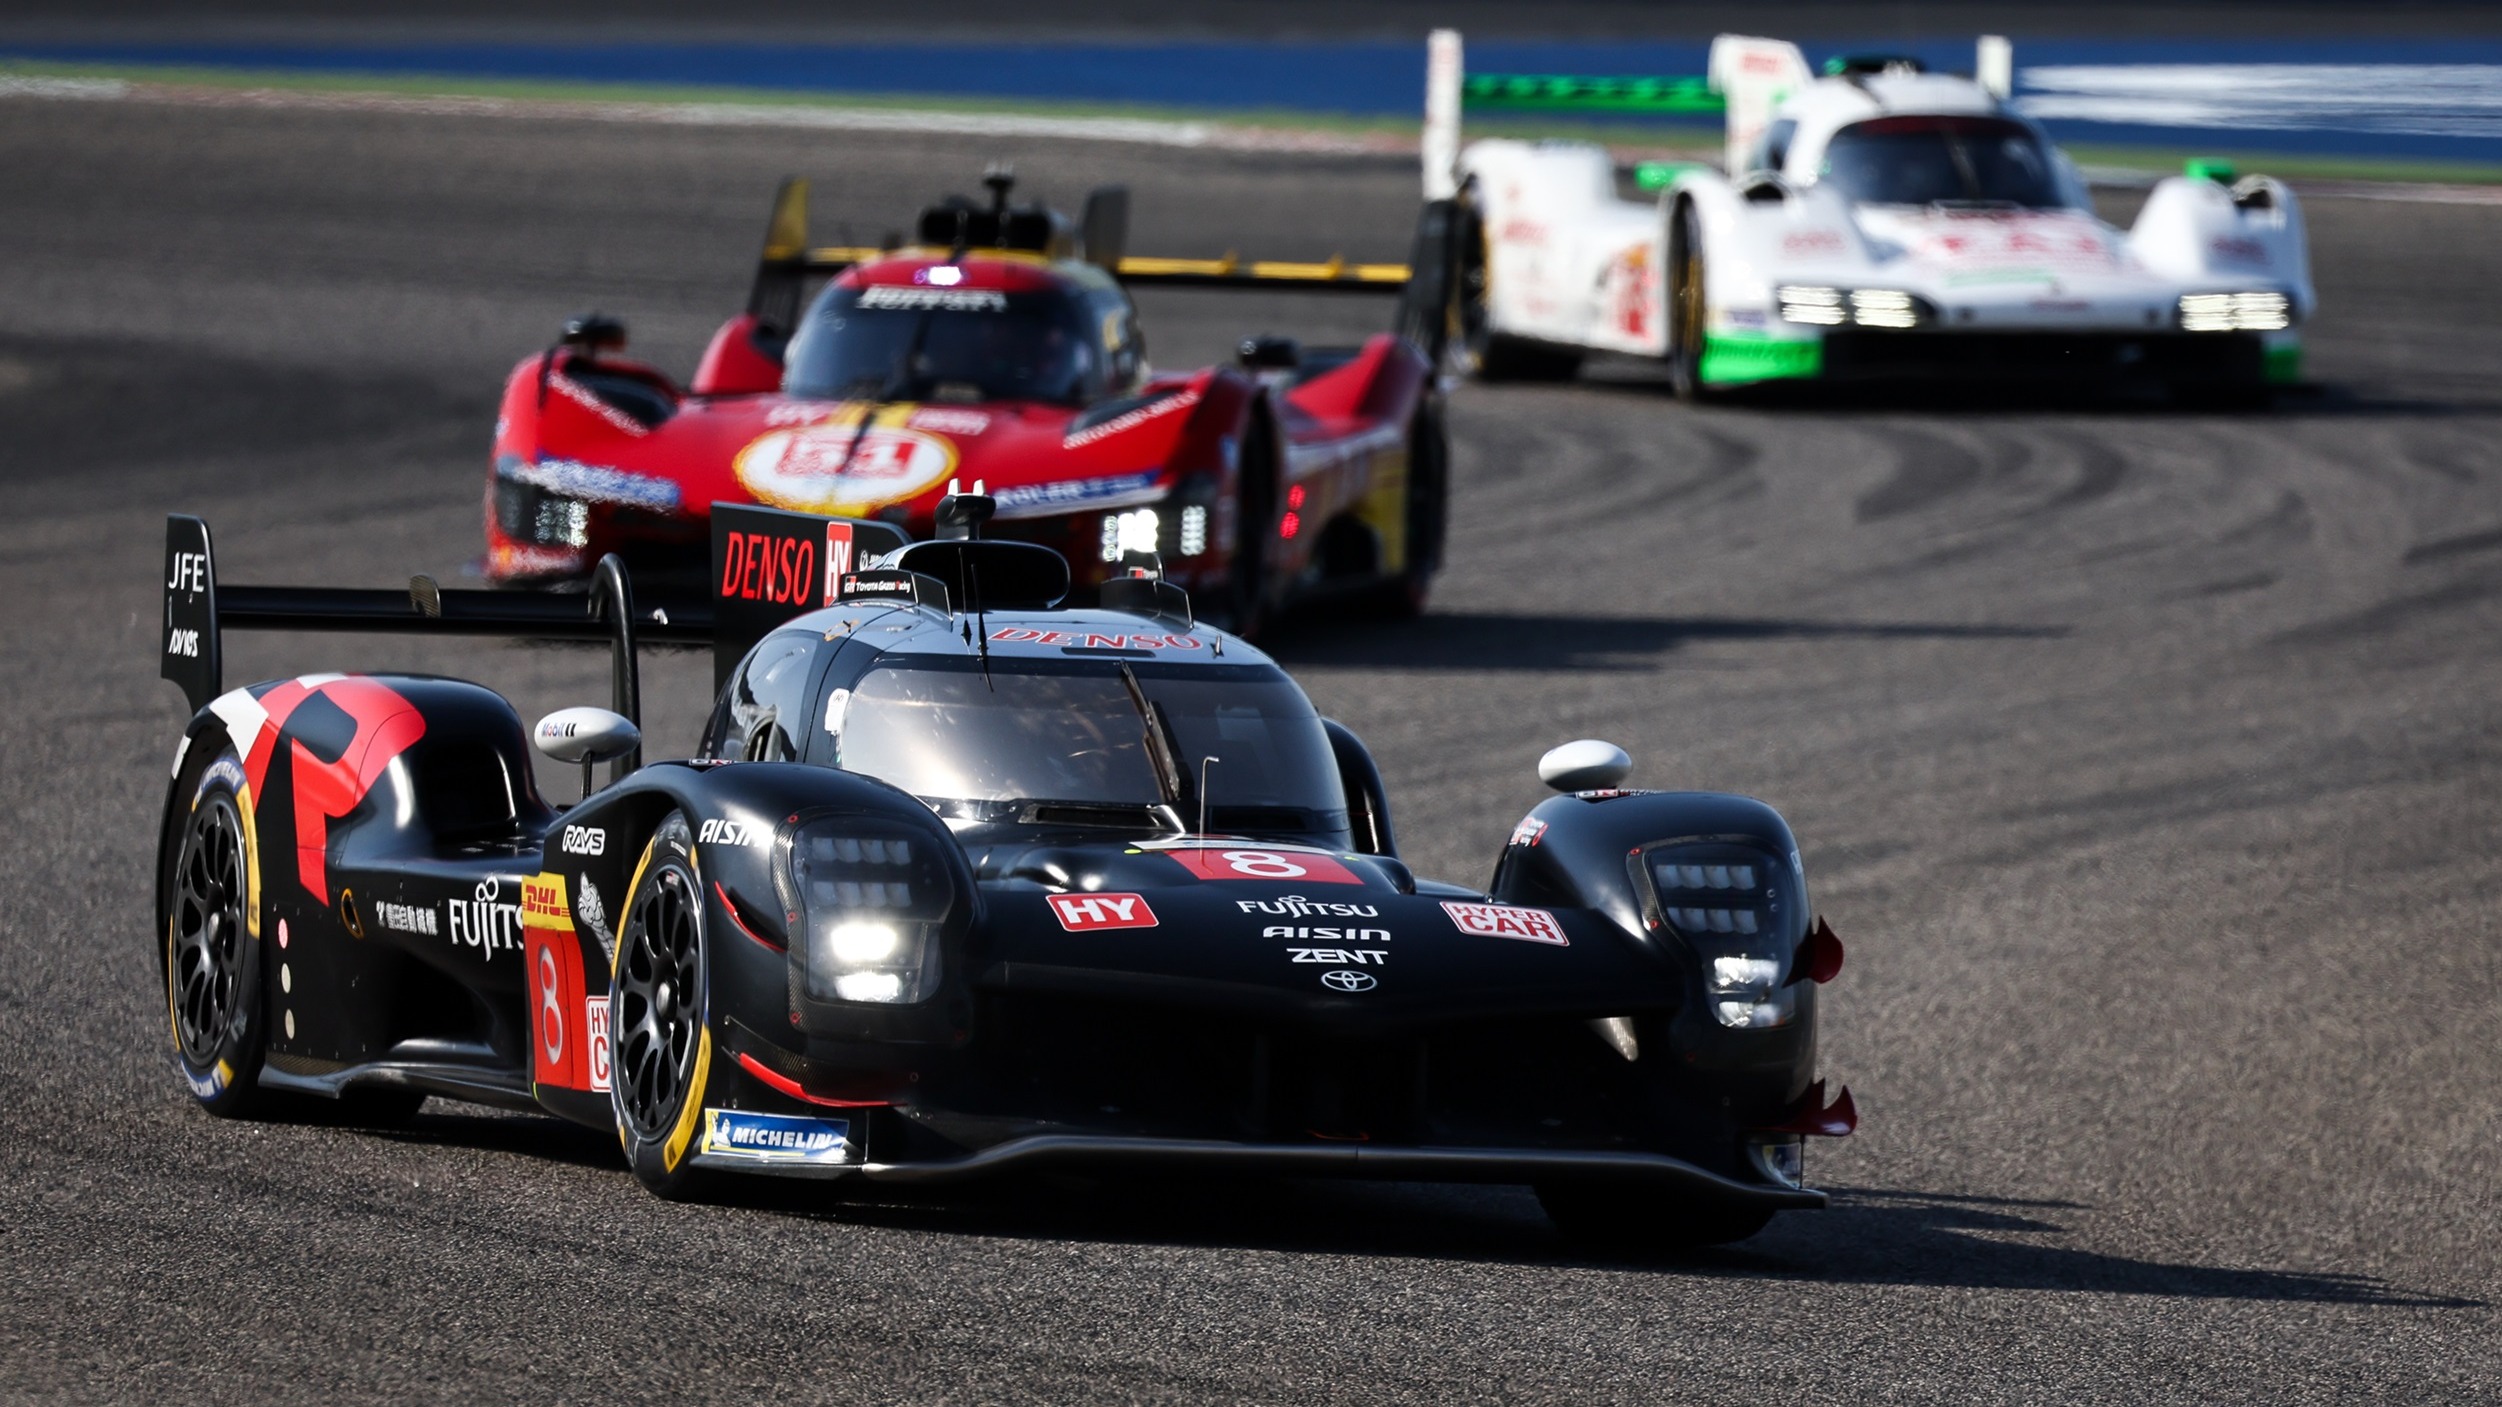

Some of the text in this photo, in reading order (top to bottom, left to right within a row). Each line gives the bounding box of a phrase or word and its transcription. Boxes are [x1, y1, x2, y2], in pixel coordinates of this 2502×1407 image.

[168, 552, 205, 593] JFE
[722, 531, 814, 606] DENSO
[826, 539, 850, 596] HY
[988, 627, 1204, 650] DENSO
[541, 722, 565, 737] Mobil
[562, 824, 606, 856] RAYS
[1222, 850, 1307, 878] 8
[524, 884, 567, 917] DHL
[1057, 898, 1136, 924] HY
[1236, 895, 1379, 918] FUJITSU
[1453, 905, 1546, 923] HYPER
[1461, 914, 1557, 940] CAR
[1263, 926, 1391, 941] AISIN
[1286, 948, 1389, 965] ZENT
[539, 943, 563, 1065] 8
[732, 1126, 833, 1150] MICHELIN
